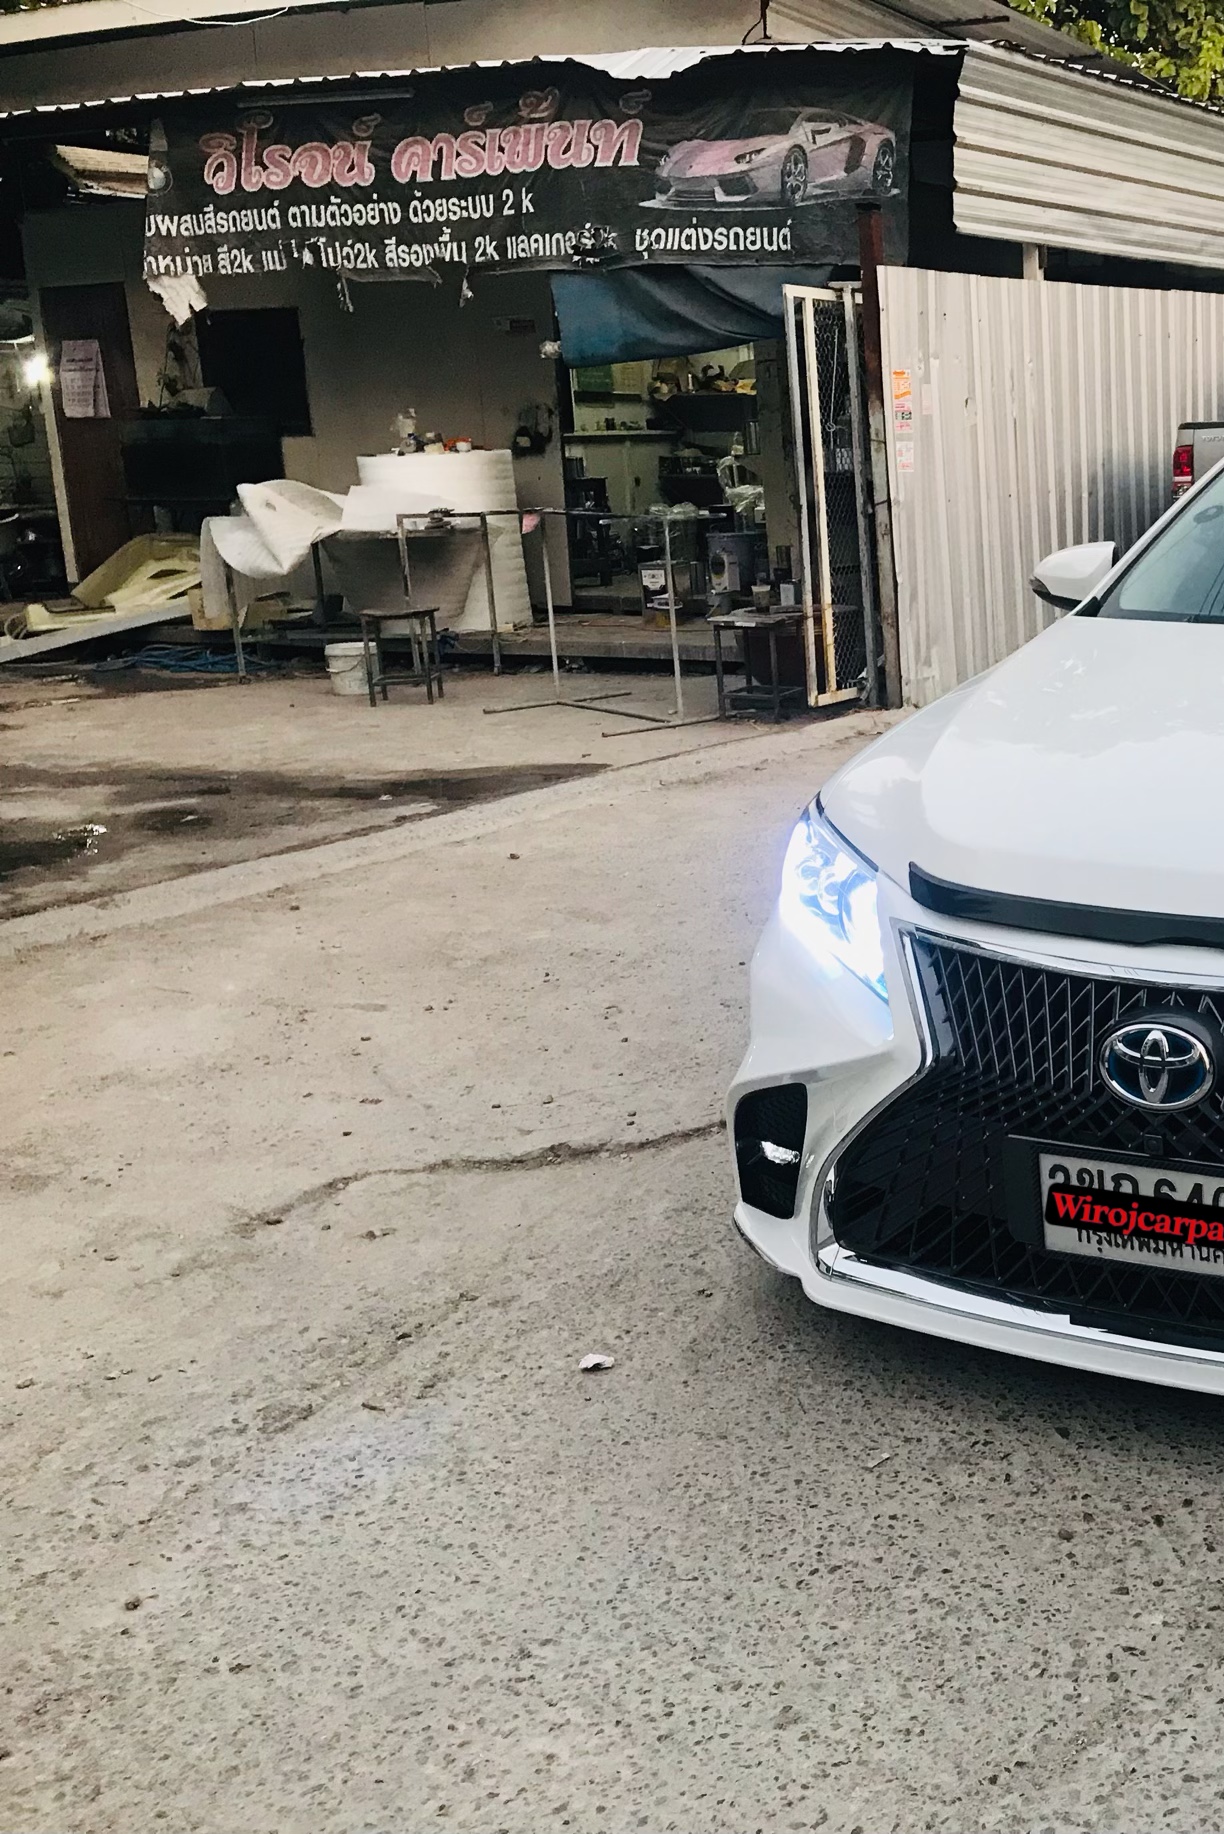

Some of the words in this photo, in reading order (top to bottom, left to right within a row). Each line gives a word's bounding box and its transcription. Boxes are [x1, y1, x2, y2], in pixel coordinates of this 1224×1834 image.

[200, 109, 382, 195] วิโรจน์
[288, 193, 402, 228] ตามตัวอย่าง
[408, 190, 495, 224] ด้วยระบบ
[501, 188, 515, 216] 2
[474, 234, 500, 263] 2k
[635, 217, 793, 260] ชุดแต่งรถยนต์
